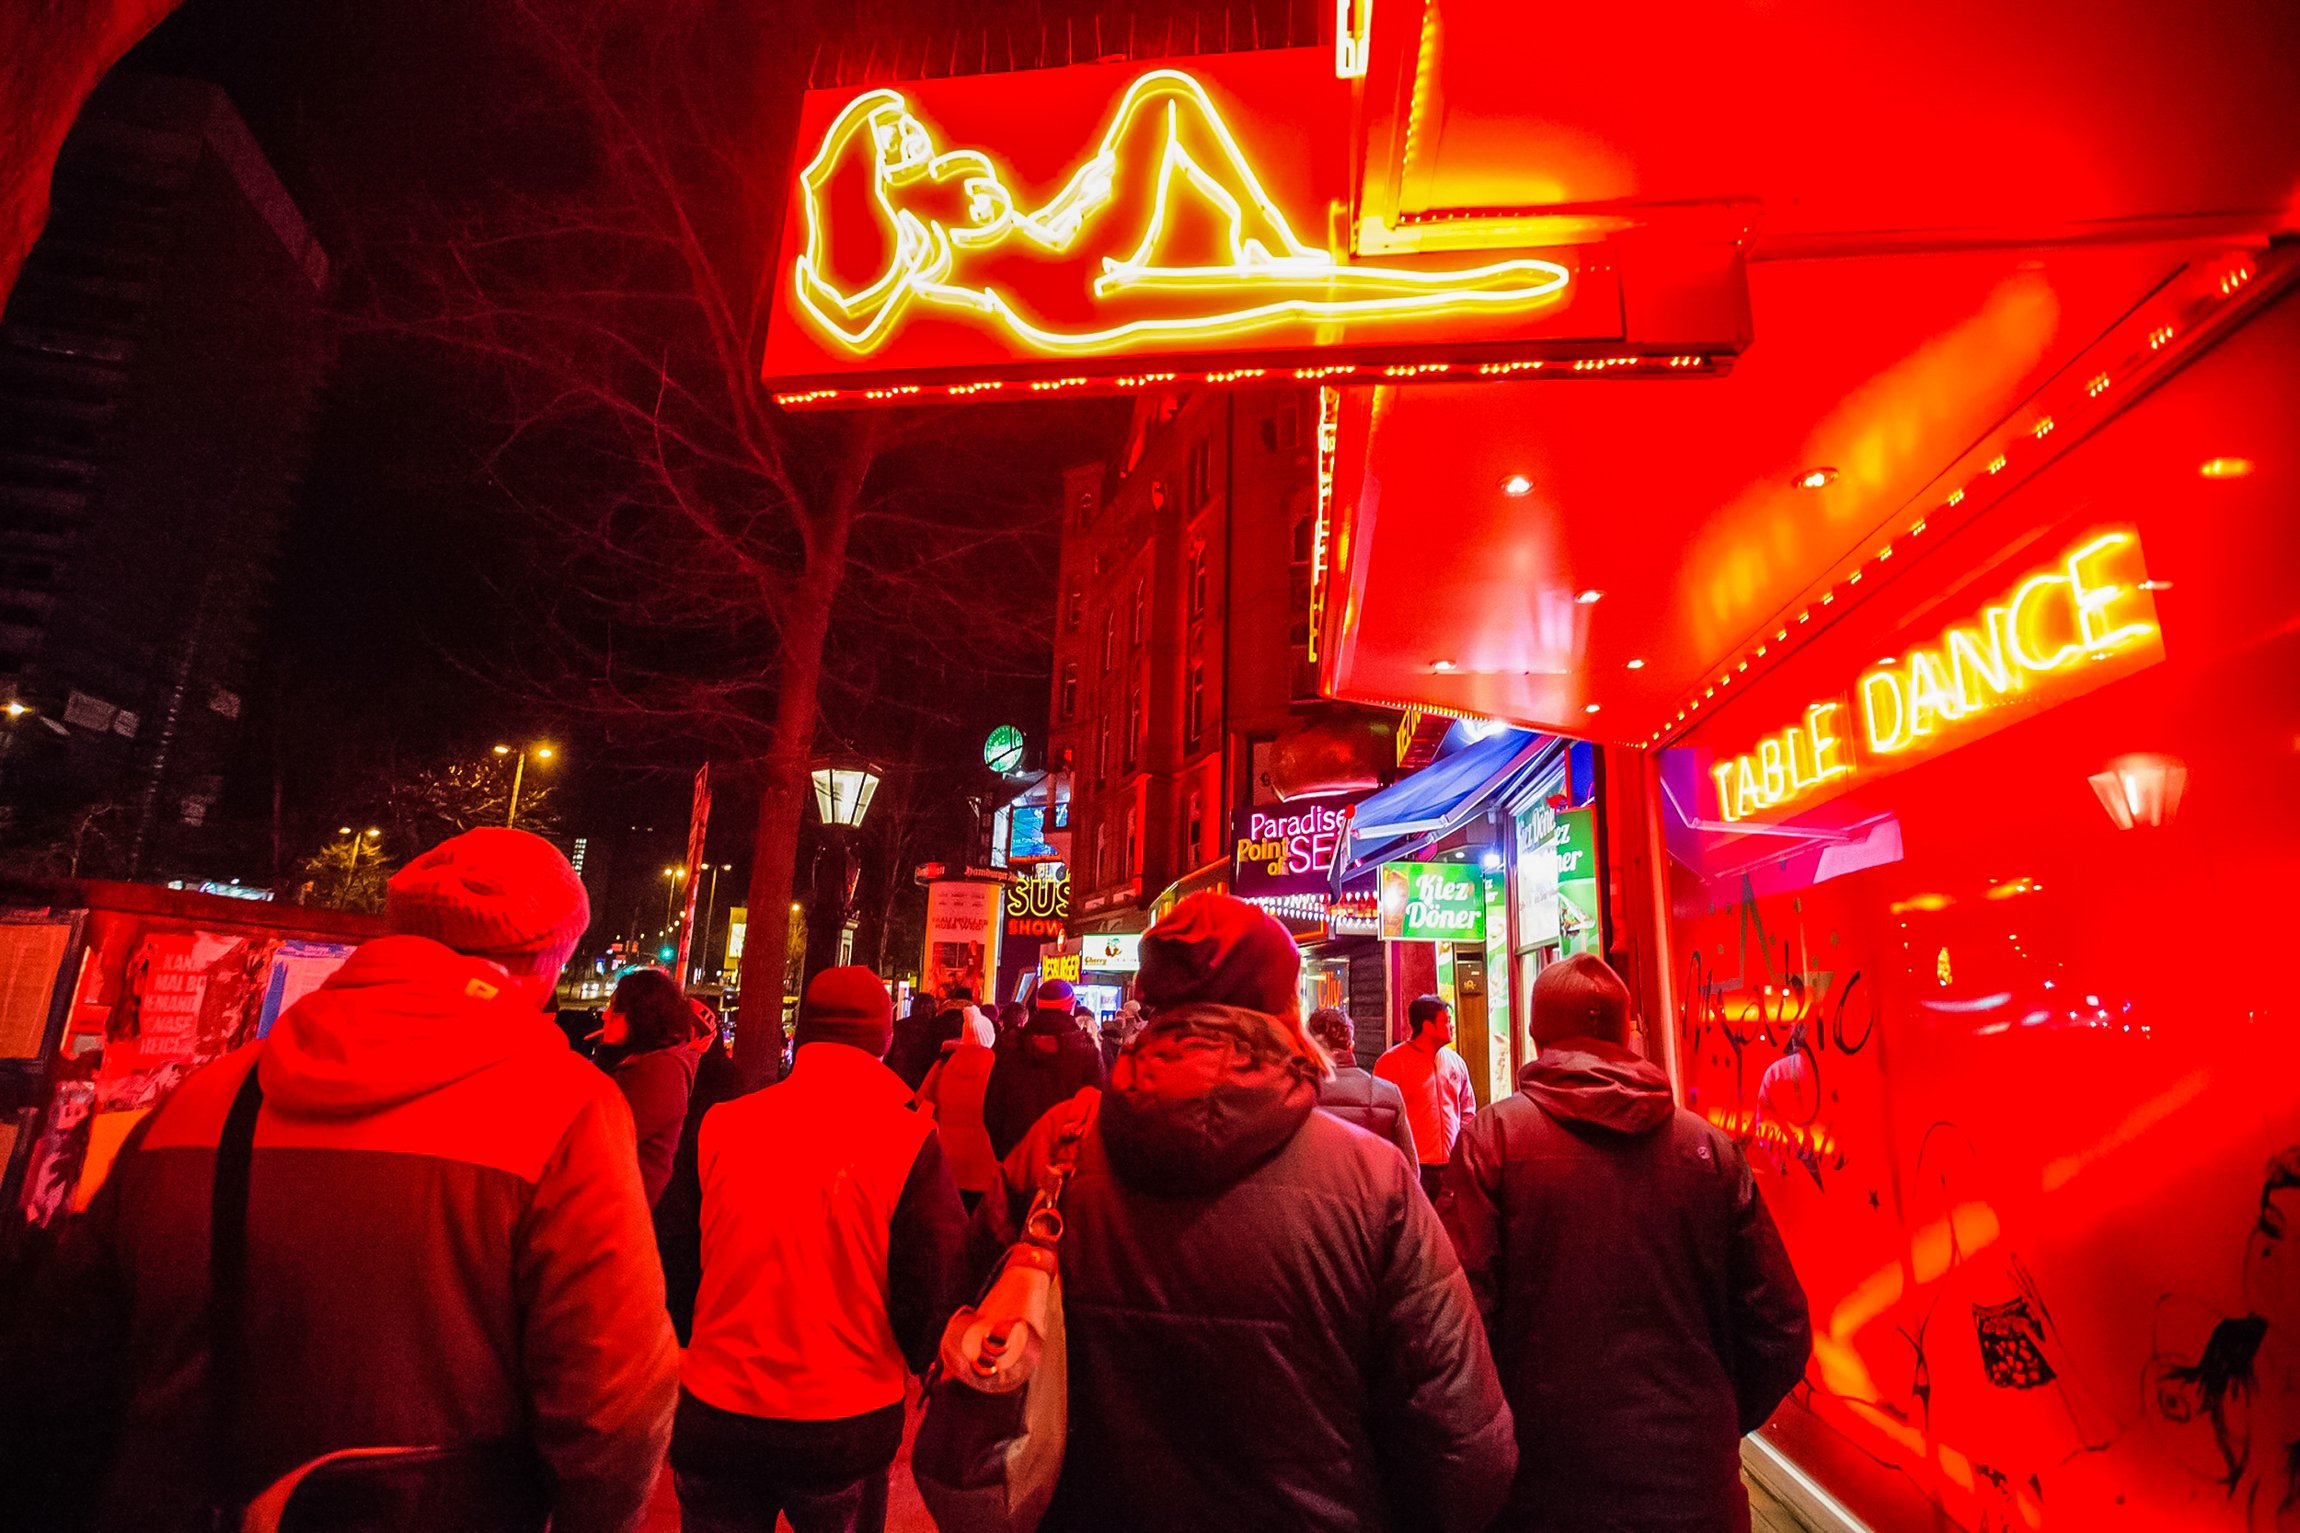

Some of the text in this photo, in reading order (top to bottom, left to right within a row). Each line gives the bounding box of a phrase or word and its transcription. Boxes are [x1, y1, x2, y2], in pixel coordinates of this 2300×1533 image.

[1712, 529, 2156, 822] TABLE DANCE
[1238, 837, 1290, 862] Point
[1289, 832, 1341, 874] SE
[1267, 857, 1289, 876] of
[1416, 874, 1469, 906] Kiez
[1406, 901, 1482, 929] Döner
